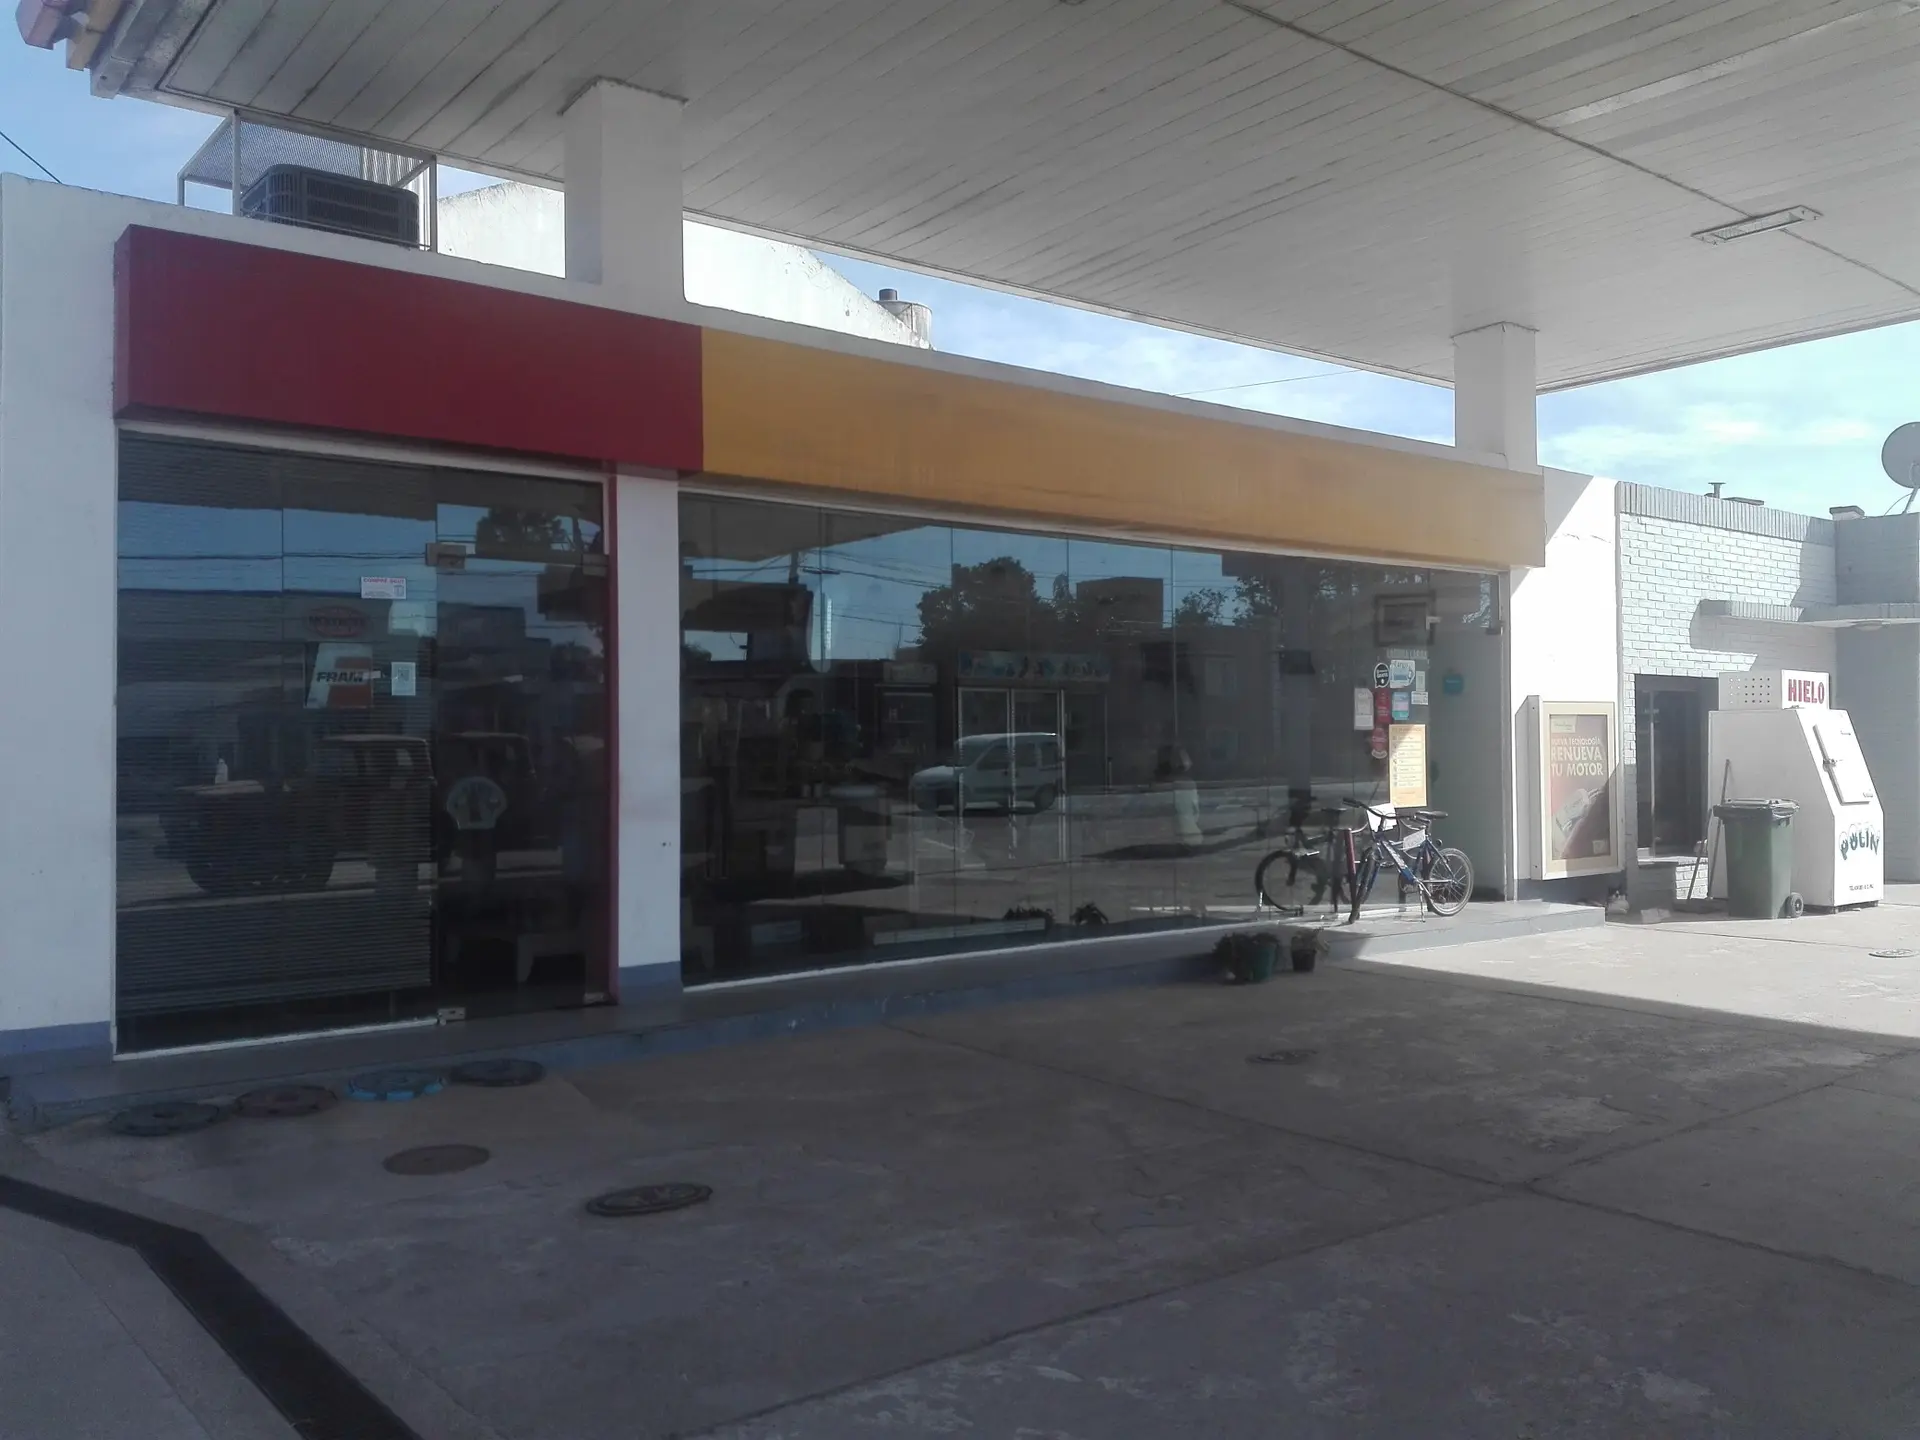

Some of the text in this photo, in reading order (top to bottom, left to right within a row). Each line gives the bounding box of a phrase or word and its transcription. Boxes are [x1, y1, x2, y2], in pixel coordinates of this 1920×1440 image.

[317, 671, 363, 682] FRAM
[1788, 678, 1825, 704] HIELO
[1551, 746, 1602, 761] RENUEVA
[1551, 762, 1604, 777] TU MOTOR
